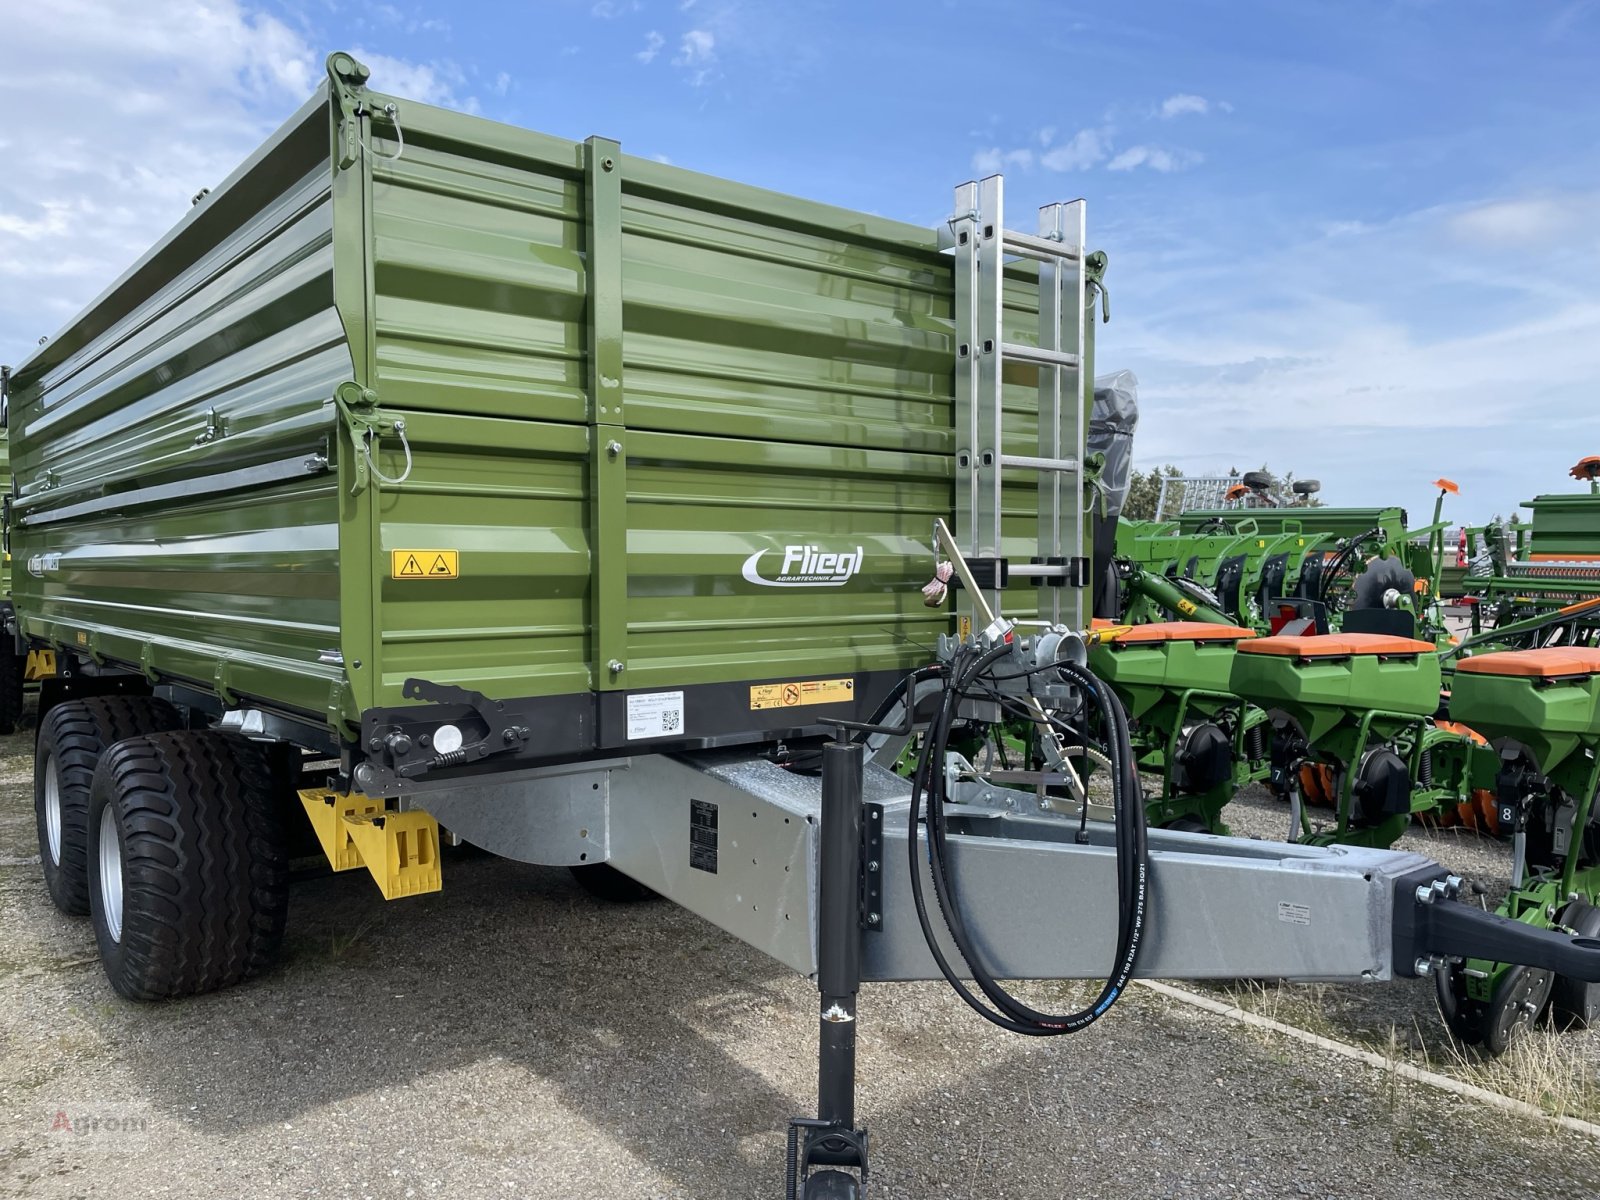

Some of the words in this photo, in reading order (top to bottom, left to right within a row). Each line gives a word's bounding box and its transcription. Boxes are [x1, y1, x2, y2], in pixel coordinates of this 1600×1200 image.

[781, 545, 863, 581] Fliegl
[1102, 742, 1108, 752] 6
[1274, 770, 1281, 781] 7
[1502, 807, 1512, 821] 8
[1117, 974, 1126, 988] SAE
[1127, 944, 1137, 963] R2AT
[1135, 915, 1141, 928] WP
